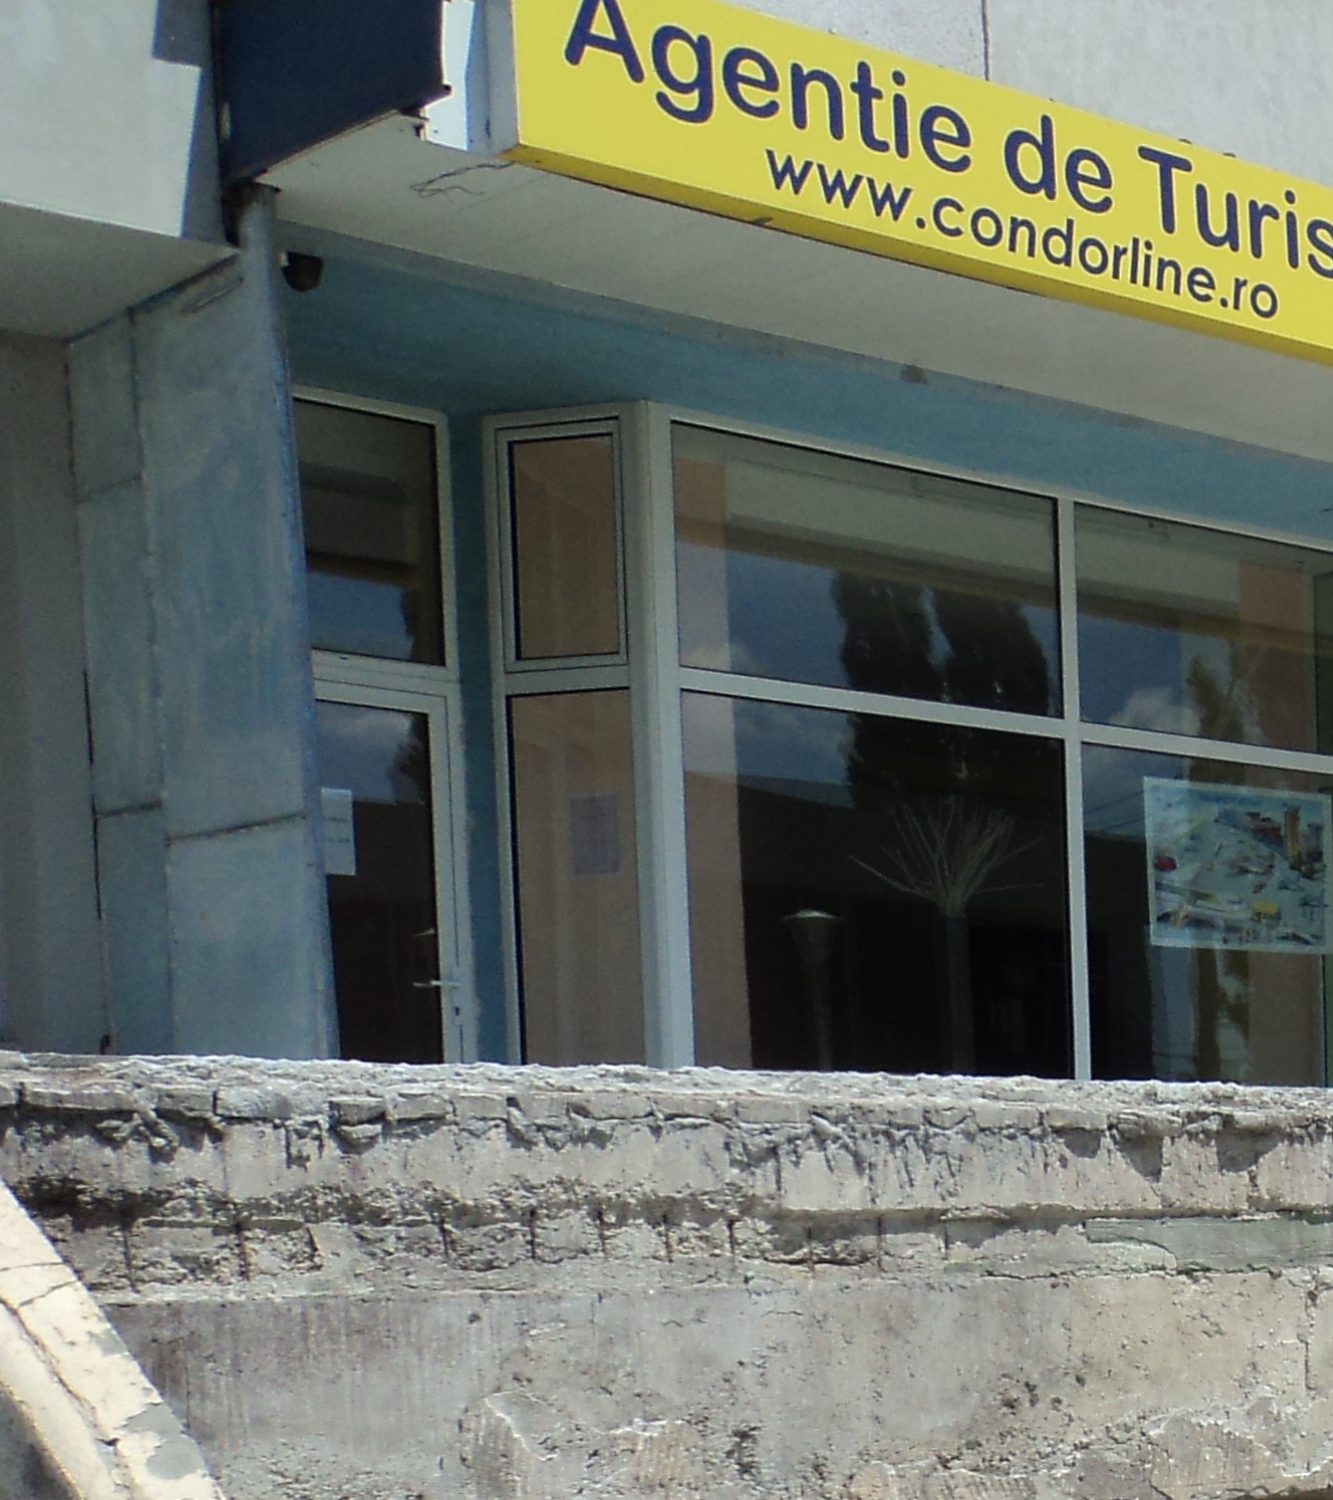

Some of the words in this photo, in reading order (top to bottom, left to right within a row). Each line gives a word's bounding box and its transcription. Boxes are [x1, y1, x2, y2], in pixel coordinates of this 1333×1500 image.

[563, 0, 972, 174] Agentie
[1003, 114, 1114, 215] de
[765, 148, 1279, 320] www.condorline.ro
